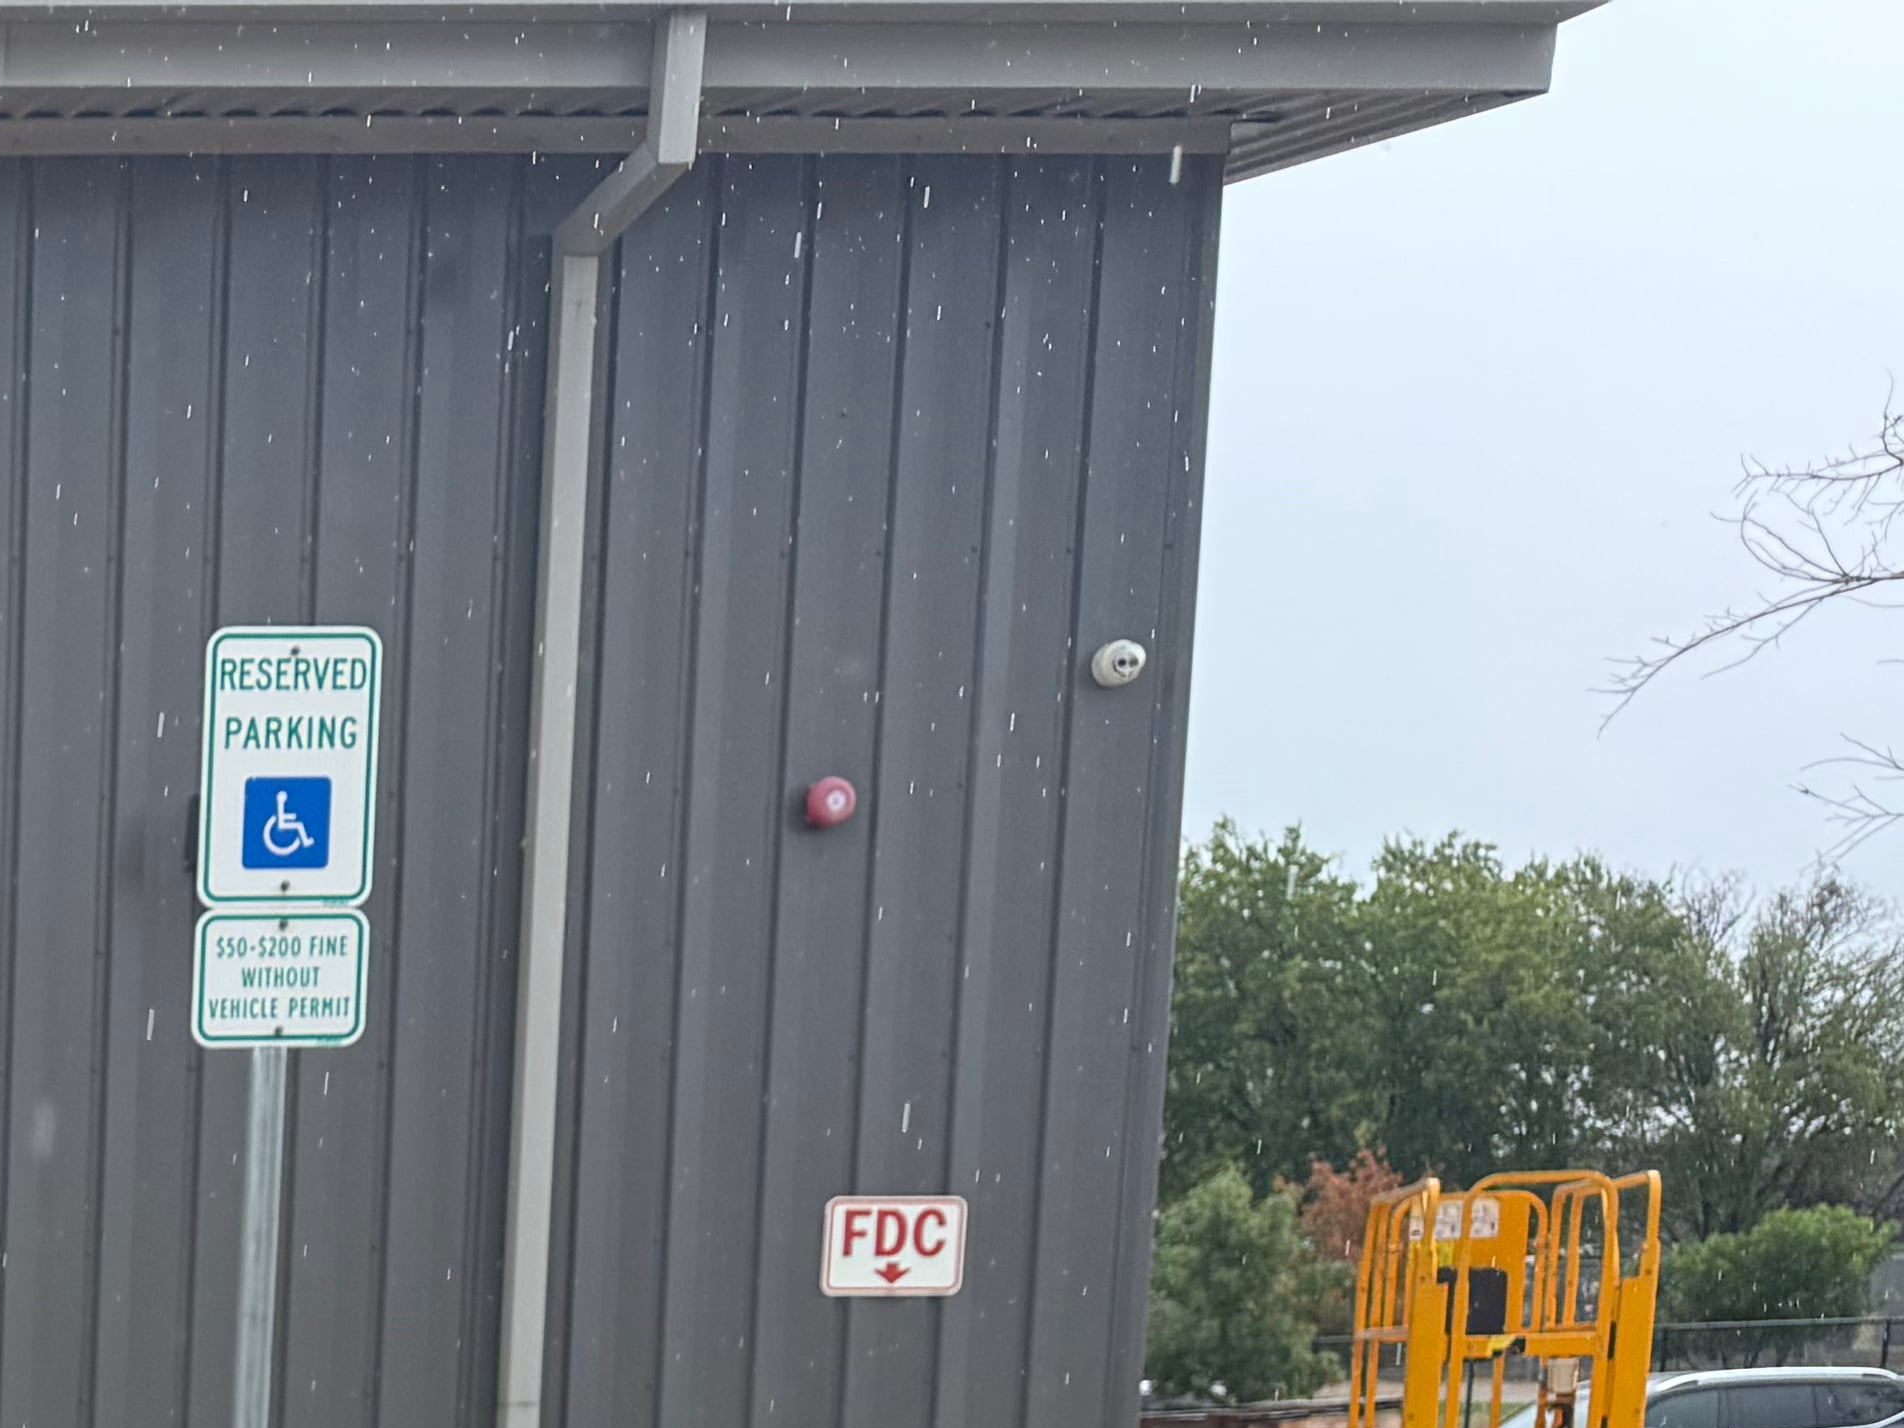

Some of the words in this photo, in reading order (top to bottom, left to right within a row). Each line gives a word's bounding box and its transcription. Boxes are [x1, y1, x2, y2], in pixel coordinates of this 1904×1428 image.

[220, 657, 367, 691] RESERVED
[224, 716, 358, 750] PARKING
[217, 936, 302, 958] $50-$200
[309, 935, 348, 957] FINE
[241, 966, 320, 988] WITHOUT
[208, 997, 278, 1020] VEHICLE
[288, 996, 350, 1018] PERMIT
[843, 1208, 947, 1258] FDC
